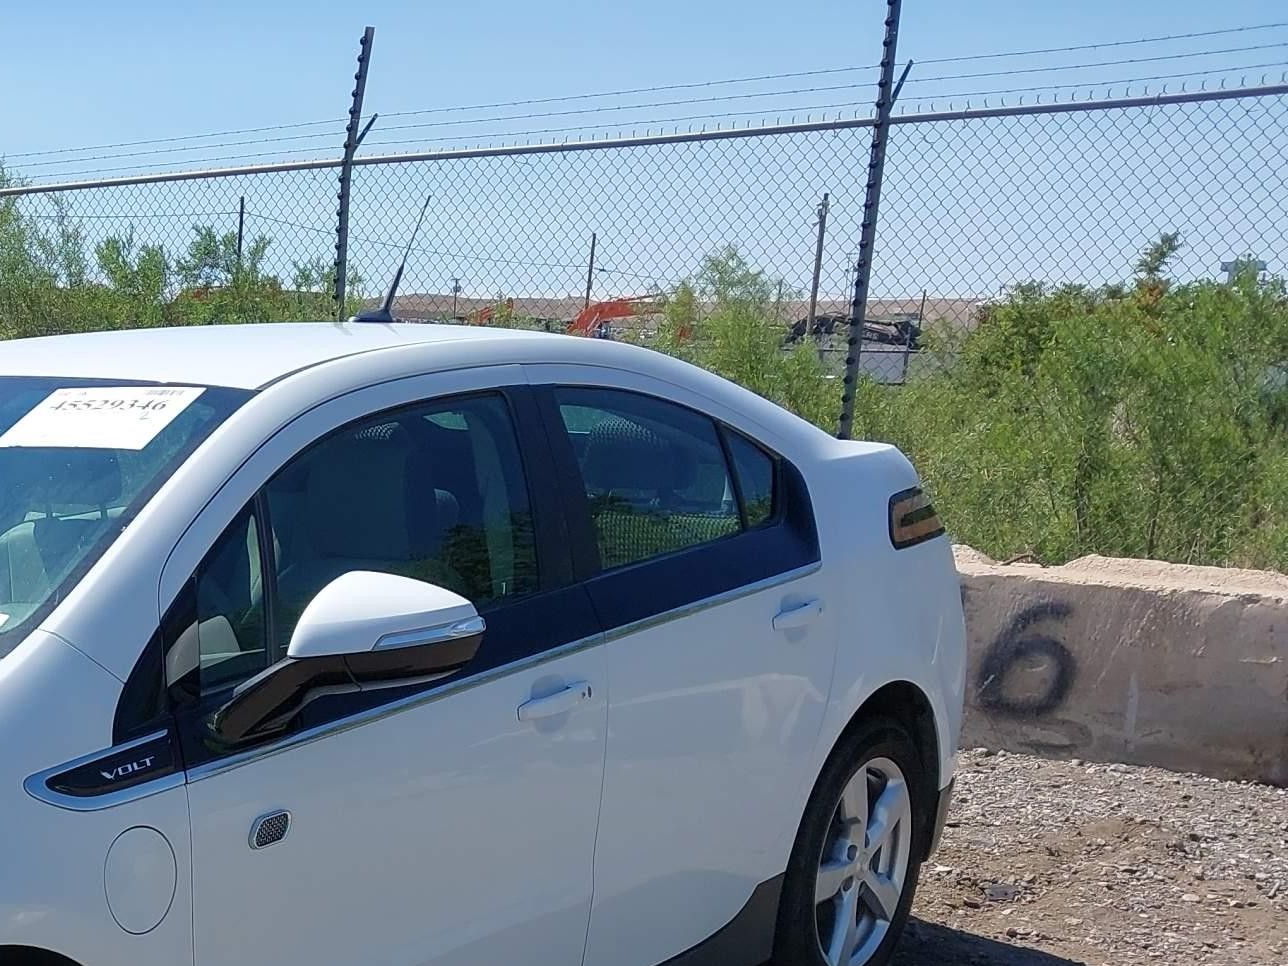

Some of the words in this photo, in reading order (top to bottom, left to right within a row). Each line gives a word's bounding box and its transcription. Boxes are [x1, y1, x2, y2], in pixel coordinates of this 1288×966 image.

[50, 399, 169, 411] 45529346
[976, 602, 1077, 718] 6
[100, 756, 155, 779] VOLT
